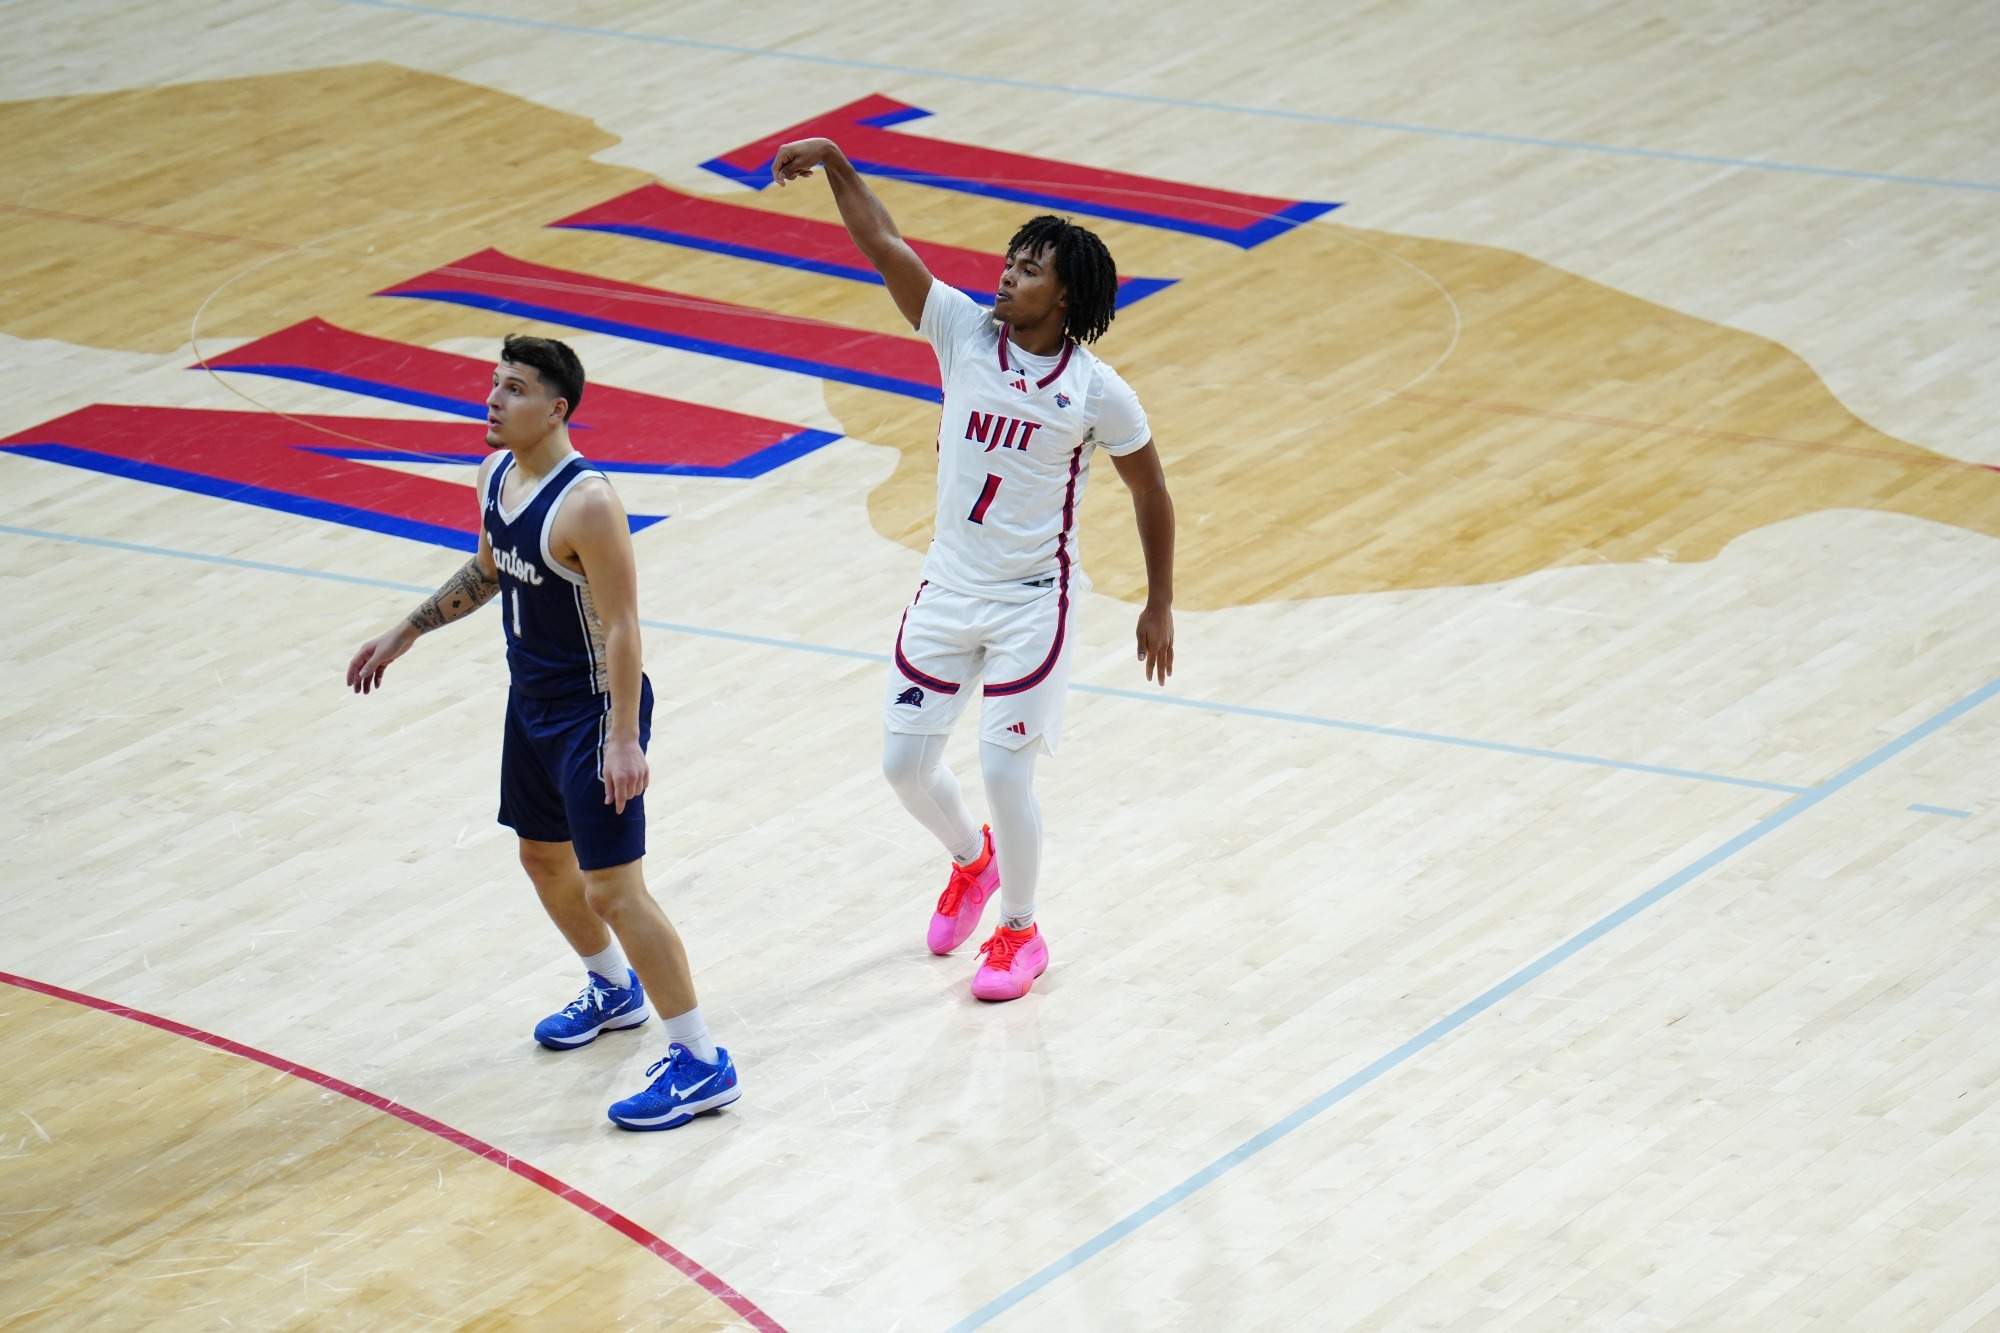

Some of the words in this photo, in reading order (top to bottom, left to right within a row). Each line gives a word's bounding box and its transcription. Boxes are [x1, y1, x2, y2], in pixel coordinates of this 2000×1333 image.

[965, 411, 1042, 452] NJIT
[967, 473, 1003, 525] 1
[511, 586, 521, 637] 1
